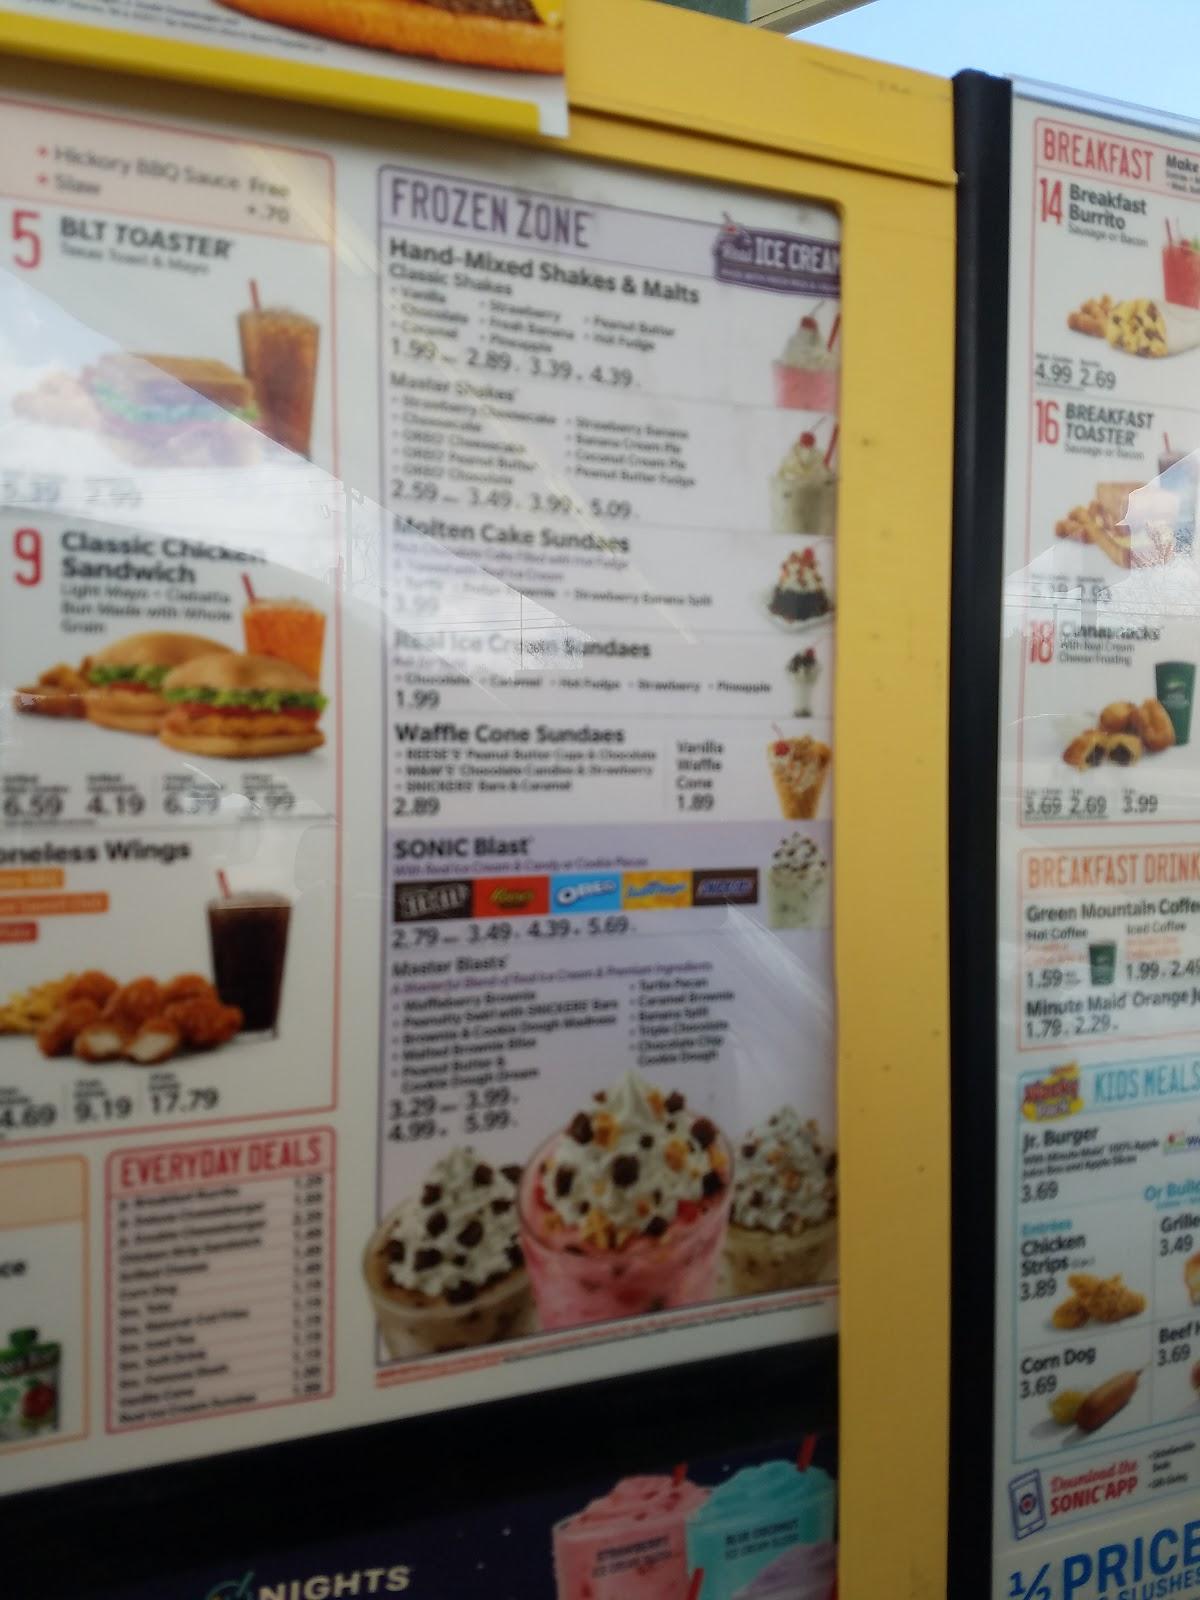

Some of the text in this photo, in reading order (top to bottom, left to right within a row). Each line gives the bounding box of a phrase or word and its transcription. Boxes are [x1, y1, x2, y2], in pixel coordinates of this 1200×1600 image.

[1042, 126, 1154, 184] BREAKFAST
[1165, 154, 1200, 174] Make
[136, 158, 180, 185] BBQ
[184, 169, 241, 193] Sauce
[391, 177, 593, 249] FROZEN ZONE
[1039, 177, 1064, 225] 14
[1068, 183, 1148, 216] Breakfast
[1068, 203, 1127, 231] Burrito
[11, 207, 43, 271] 5
[58, 214, 233, 260] BLT TOASTER
[755, 236, 786, 269] ICE
[390, 237, 534, 279] Hand-Mixed
[538, 260, 616, 293] Shakes
[621, 275, 637, 296] &
[641, 277, 701, 305] Malts
[1035, 361, 1117, 391] 4.99 2.69
[1034, 399, 1060, 447] 16
[1064, 402, 1155, 431] BREAKFAST
[1064, 421, 1135, 448] TOASTER
[60, 530, 153, 557] Classic
[480, 522, 537, 547] Cake
[13, 526, 43, 588] 9
[61, 557, 196, 585] Sandwich
[394, 688, 441, 711] 1.99
[394, 722, 625, 744] Waffle Cone Sundaes
[675, 740, 726, 756] Vanilla
[675, 757, 724, 773] Waffle
[675, 774, 714, 791] Cone
[392, 796, 441, 818] 2.89
[676, 793, 716, 812] 1.89
[1122, 794, 1159, 815] 3.99
[105, 839, 192, 865] Wings
[393, 834, 533, 859] SONIC Blast
[1027, 852, 1139, 889] BREAKFAST
[1026, 904, 1078, 924] Green
[1081, 900, 1156, 920] Mountain
[392, 915, 630, 949] 2.79 3.49 4.39 5.69
[1027, 968, 1063, 989] 1.59
[1126, 961, 1161, 981] 1.99
[1026, 988, 1188, 1017] Minute Maid Orange
[1094, 1068, 1140, 1103] KIDS
[150, 1087, 220, 1114] 17.79
[1023, 1127, 1099, 1153] Jr. Burger
[120, 1135, 323, 1188] EVERYDAY DEALS
[1021, 1180, 1060, 1203] 3.69
[1021, 1234, 1087, 1258] Chicken
[1159, 1234, 1194, 1257] 3.49
[1021, 1256, 1069, 1278] Strips
[1020, 1277, 1059, 1301] 3.89
[1158, 1322, 1193, 1345] Beef
[1020, 1347, 1097, 1376] Corn Dog
[1157, 1343, 1192, 1368] 3.69
[1019, 1373, 1058, 1400] 3.69
[1049, 1475, 1140, 1517] SONIC APP
[1062, 1519, 1200, 1600] PRICE
[257, 1564, 413, 1600] NIGHTS
